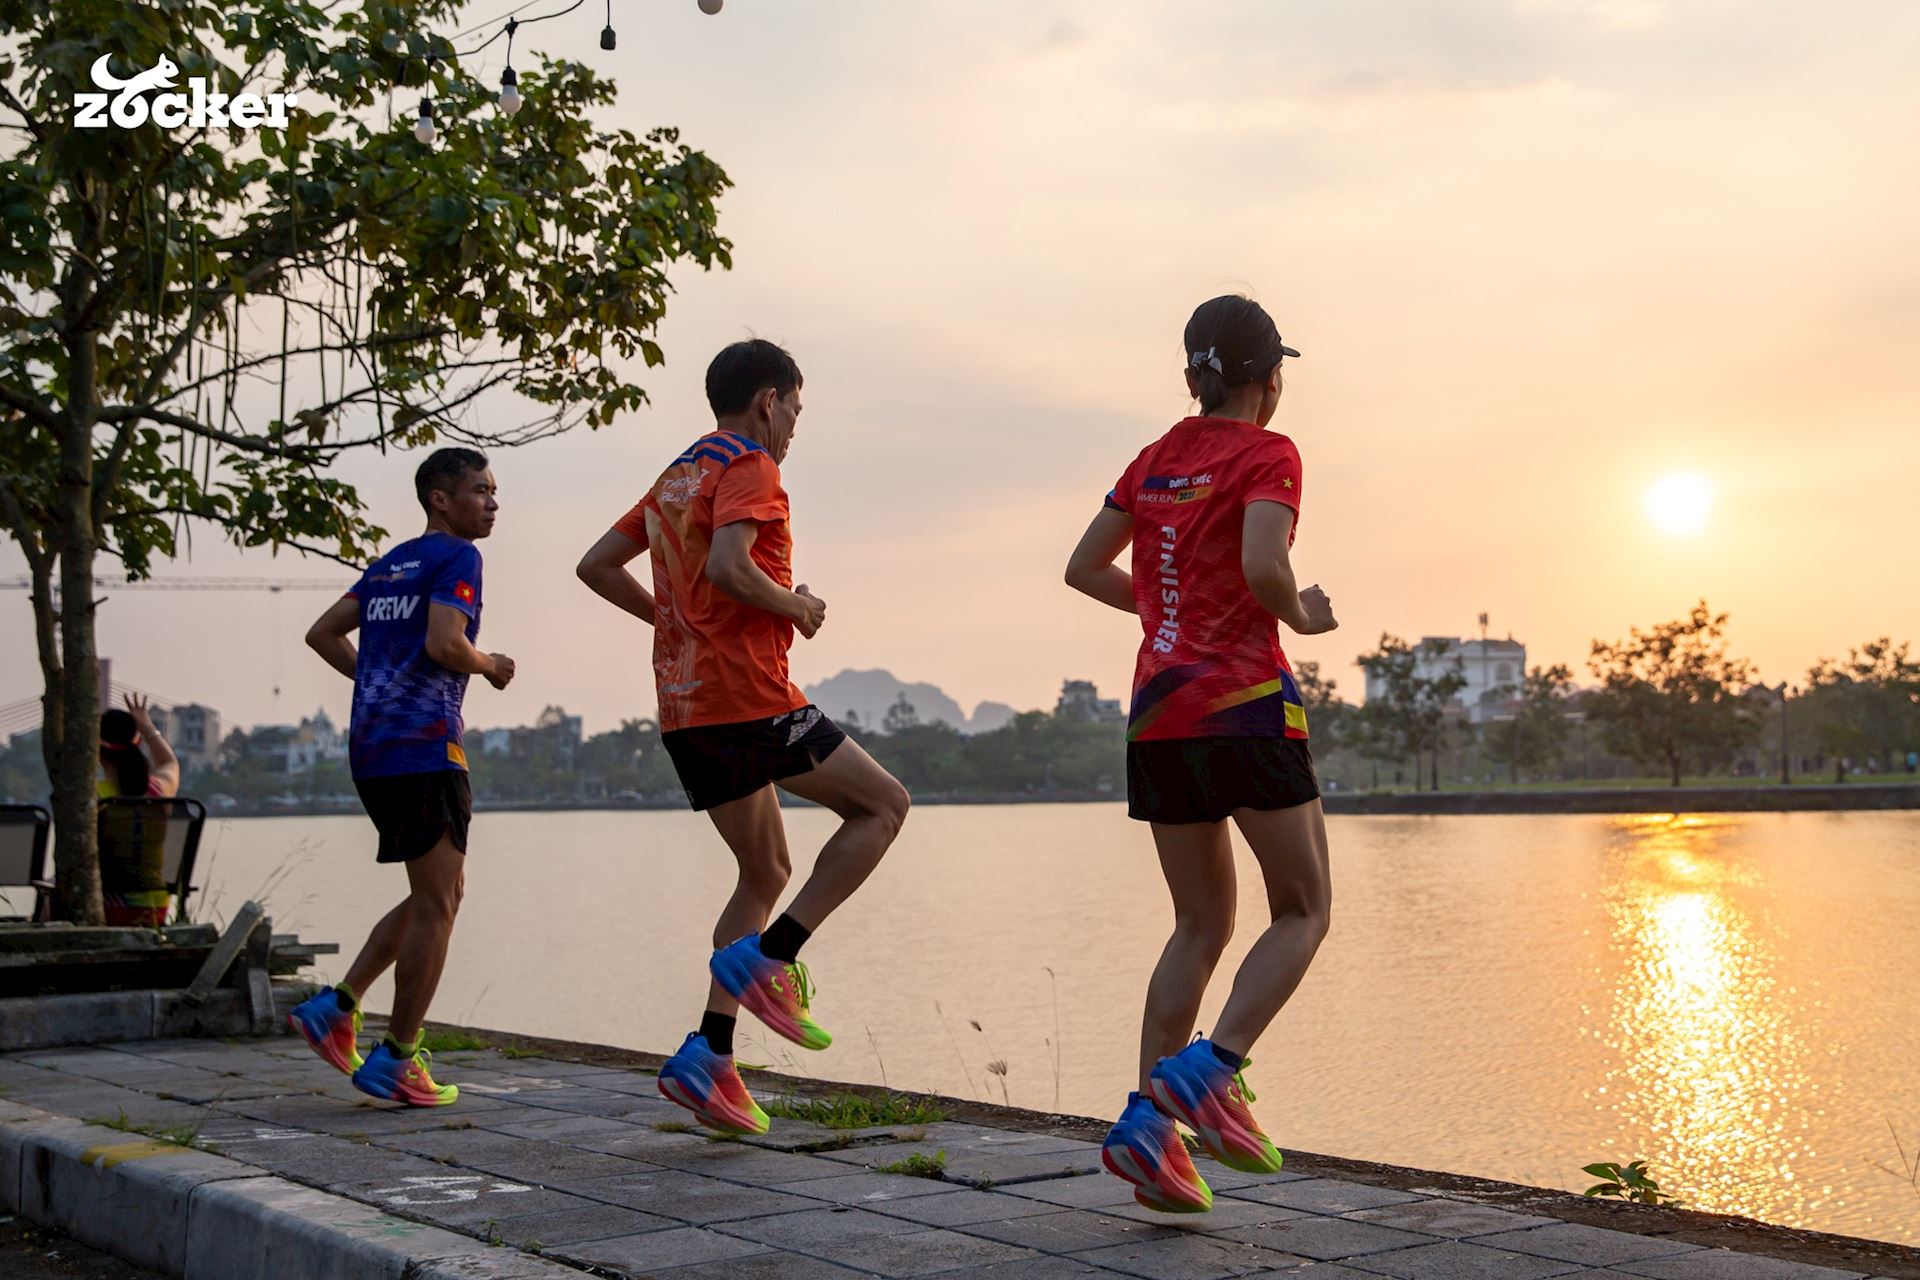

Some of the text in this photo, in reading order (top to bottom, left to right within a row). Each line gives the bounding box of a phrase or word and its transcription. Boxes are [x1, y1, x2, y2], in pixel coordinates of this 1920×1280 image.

[1158, 493, 1175, 503] RUN
[1152, 525, 1180, 654] FINISHER
[366, 595, 421, 622] CREW
